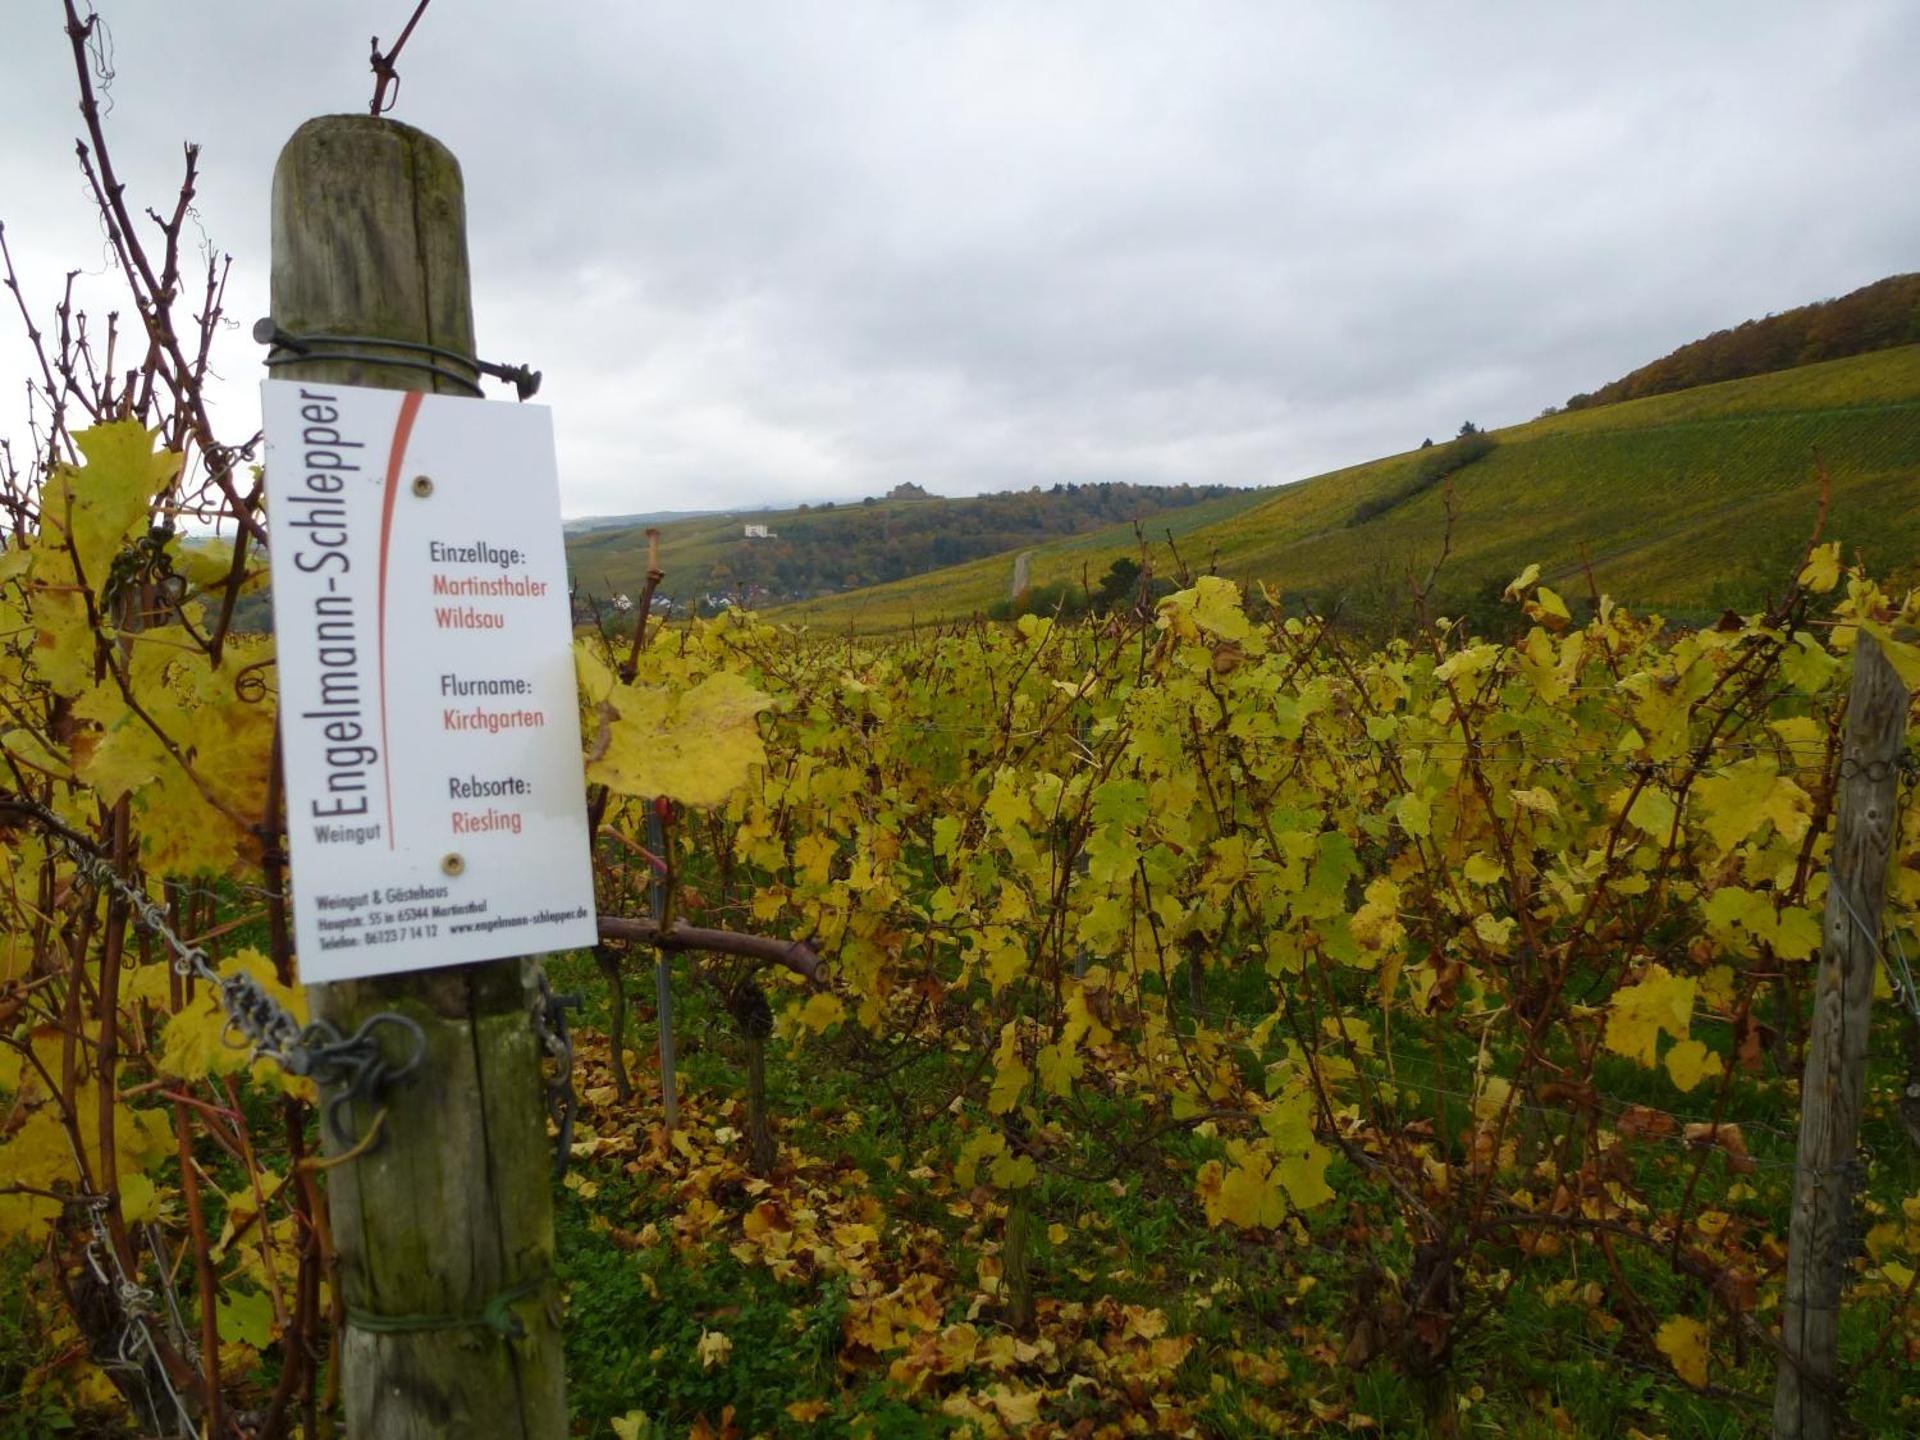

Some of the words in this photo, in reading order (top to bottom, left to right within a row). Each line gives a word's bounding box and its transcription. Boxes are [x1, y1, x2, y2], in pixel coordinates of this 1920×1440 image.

[430, 541, 526, 569] Einzellage:
[432, 574, 547, 597] Martinsthaler
[288, 388, 378, 819] Engelmann-Schlepper
[435, 606, 505, 629] Wildsau
[440, 673, 532, 697] Flurname:
[444, 706, 544, 734] Kirchgarten
[449, 774, 532, 799] Rebsorte:
[452, 807, 522, 834] Riesling
[314, 822, 381, 846] Weingut
[315, 894, 369, 911] Weingut
